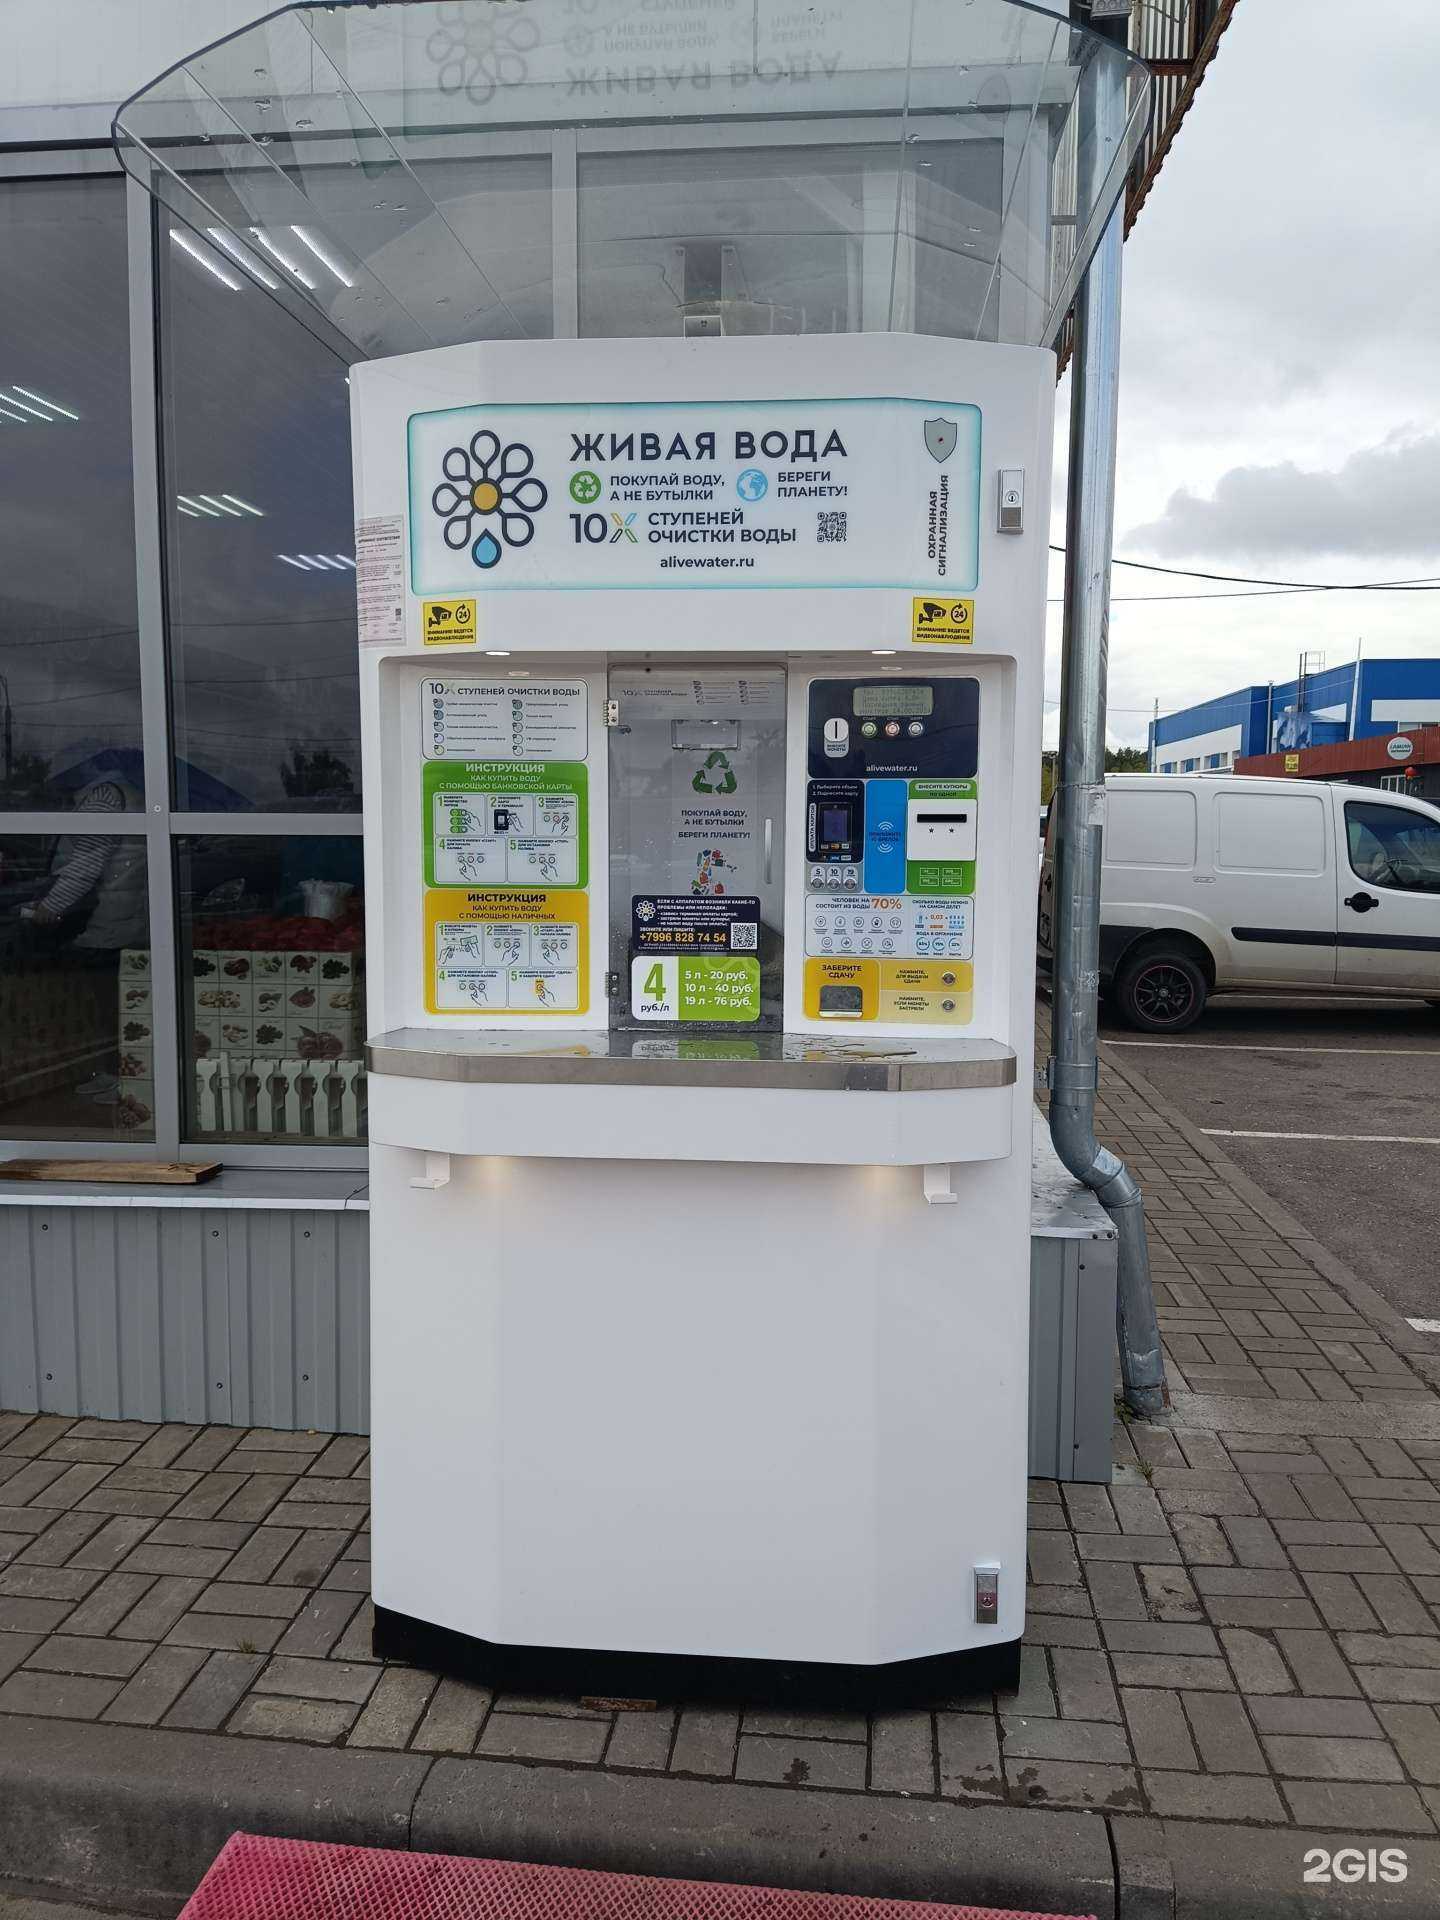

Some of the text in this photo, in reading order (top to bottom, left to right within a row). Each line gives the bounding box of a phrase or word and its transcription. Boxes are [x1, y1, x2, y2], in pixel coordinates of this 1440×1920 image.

[569, 429, 848, 462] ЖИВАЯ ВОДА
[610, 473, 726, 488] ПОКУПАЙ ВОДУ,
[777, 470, 831, 483] БЕРЕГИ
[610, 488, 714, 501] А НЕ БУТЫЛКИ
[777, 484, 848, 499] ПЛАНЕТУ!
[648, 507, 744, 526] СТУПЕНЕЙ
[928, 491, 937, 559] ОХРАННАЯ
[937, 474, 949, 577] СИГНАЛИЗАЦИЯ
[648, 528, 796, 544] ОЧИСТКИ ВОДЫ
[660, 555, 755, 569] alivewater.ru
[458, 610, 468, 619] 24
[954, 609, 965, 620] 24
[457, 687, 505, 695] СТУПЕНЕЙ
[552, 688, 580, 696] ВОДЫ
[465, 763, 545, 774] ИНСТРУКЦИЯ
[866, 764, 918, 772] alivewater.ru
[491, 782, 545, 790] БАНКОВСКОЙ
[490, 797, 496, 808] 2
[538, 797, 544, 808] 3
[681, 809, 748, 818] ПОКУПАЙ ВОДУ,
[439, 839, 445, 850] 4
[510, 840, 516, 851] 5
[467, 893, 547, 903] ИНСТРУКЦИЯ
[871, 898, 902, 910] 70%
[486, 925, 492, 936] 2
[533, 926, 540, 936] 3
[640, 933, 727, 943] +7996 828 74 54
[822, 964, 862, 972] ЗАБЕРИТЕ
[439, 972, 445, 982] 4
[511, 972, 518, 982] 5
[685, 971, 692, 979] 5
[710, 971, 724, 979] 20
[725, 971, 749, 981] руб.
[828, 971, 855, 979] СДАЧУ
[643, 963, 667, 1002] 4
[685, 984, 696, 992] 10
[714, 984, 728, 992] 40
[731, 983, 754, 994] руб.
[685, 997, 696, 1005] 19
[714, 997, 727, 1006] 76
[729, 997, 752, 1007] руб.
[641, 1003, 670, 1013] руб./л
